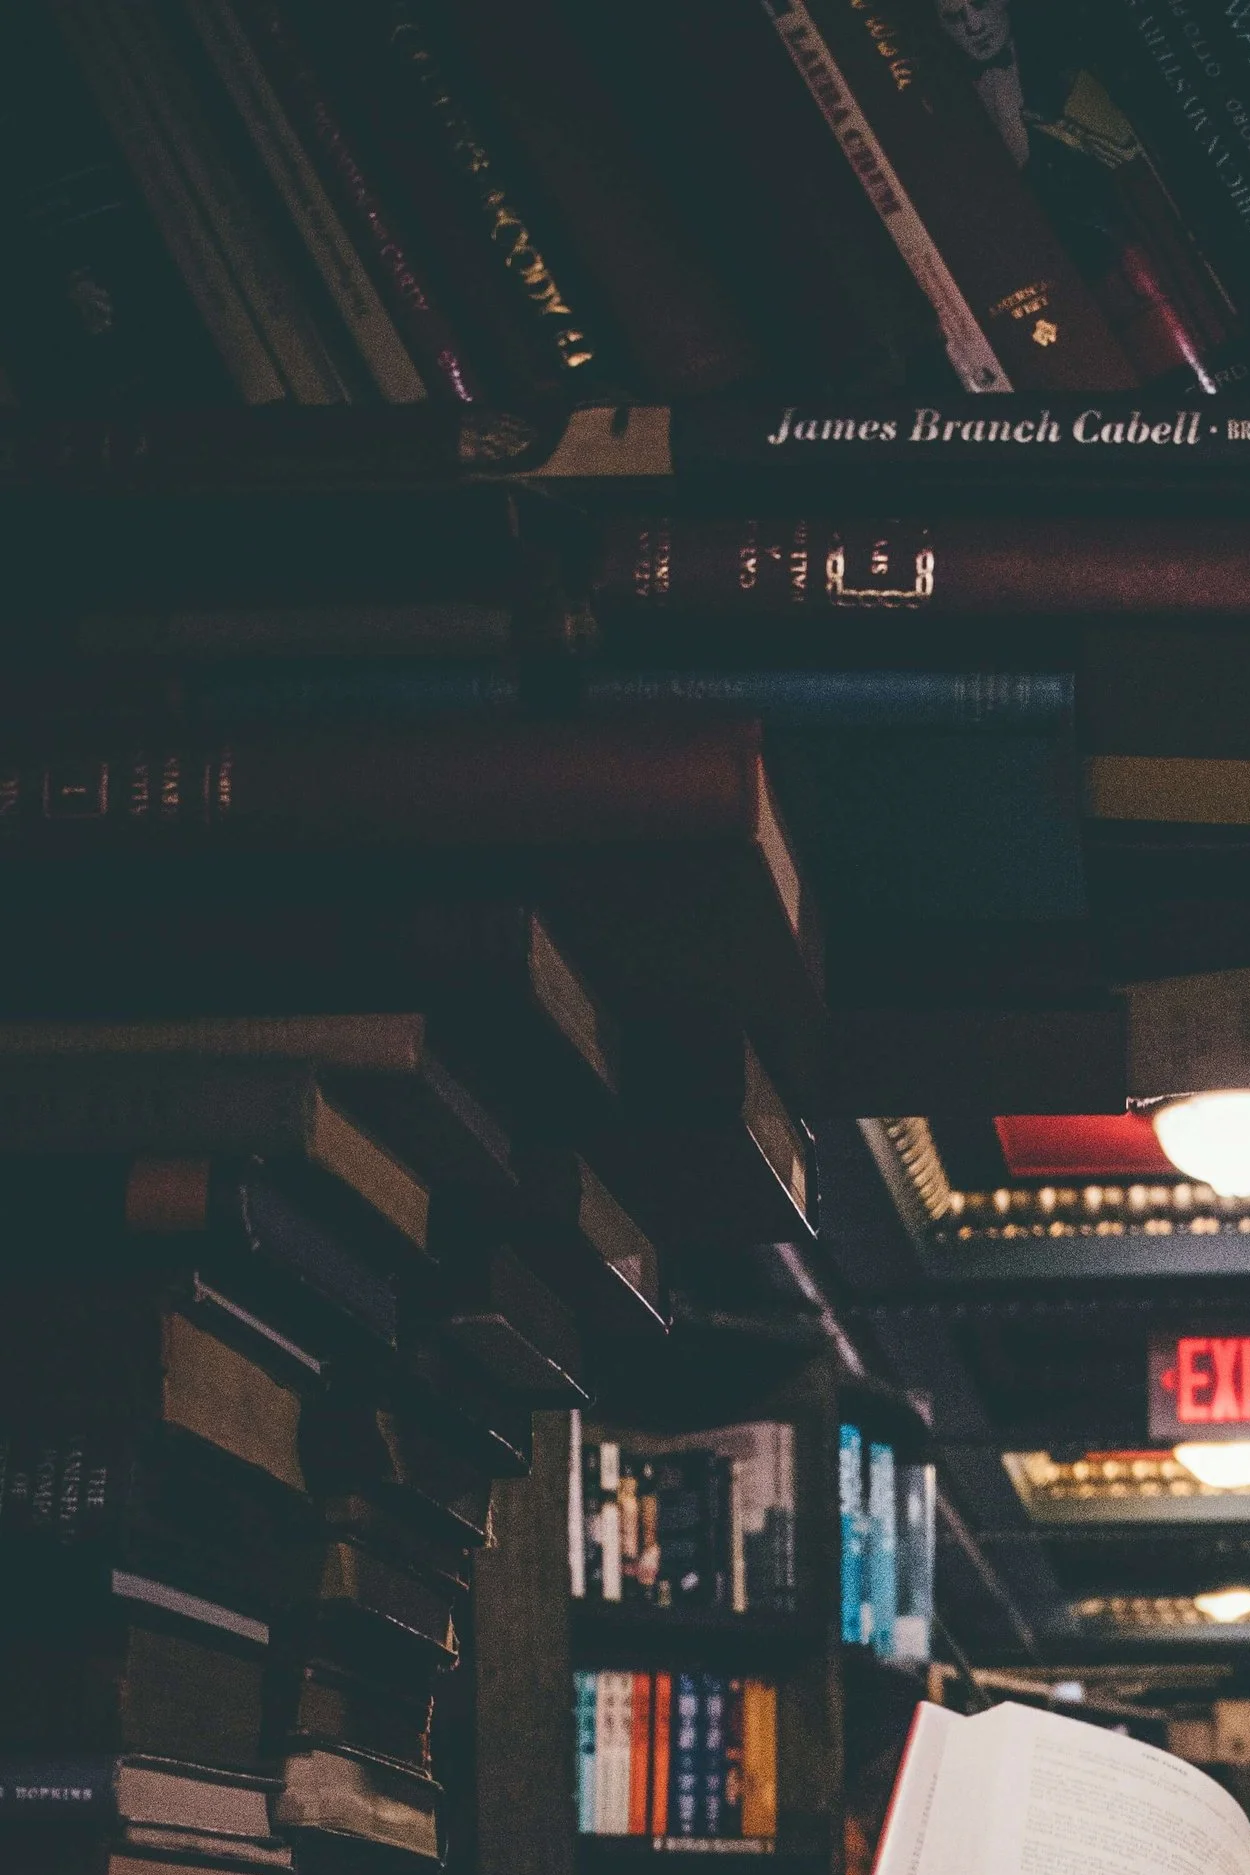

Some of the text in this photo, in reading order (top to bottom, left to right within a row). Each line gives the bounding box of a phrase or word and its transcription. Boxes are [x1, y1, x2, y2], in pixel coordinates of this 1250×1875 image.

[766, 409, 898, 446] James
[909, 409, 1061, 445] Branch
[1072, 409, 1202, 446] Cabell
[15, 1786, 93, 1802] HOPKINS
